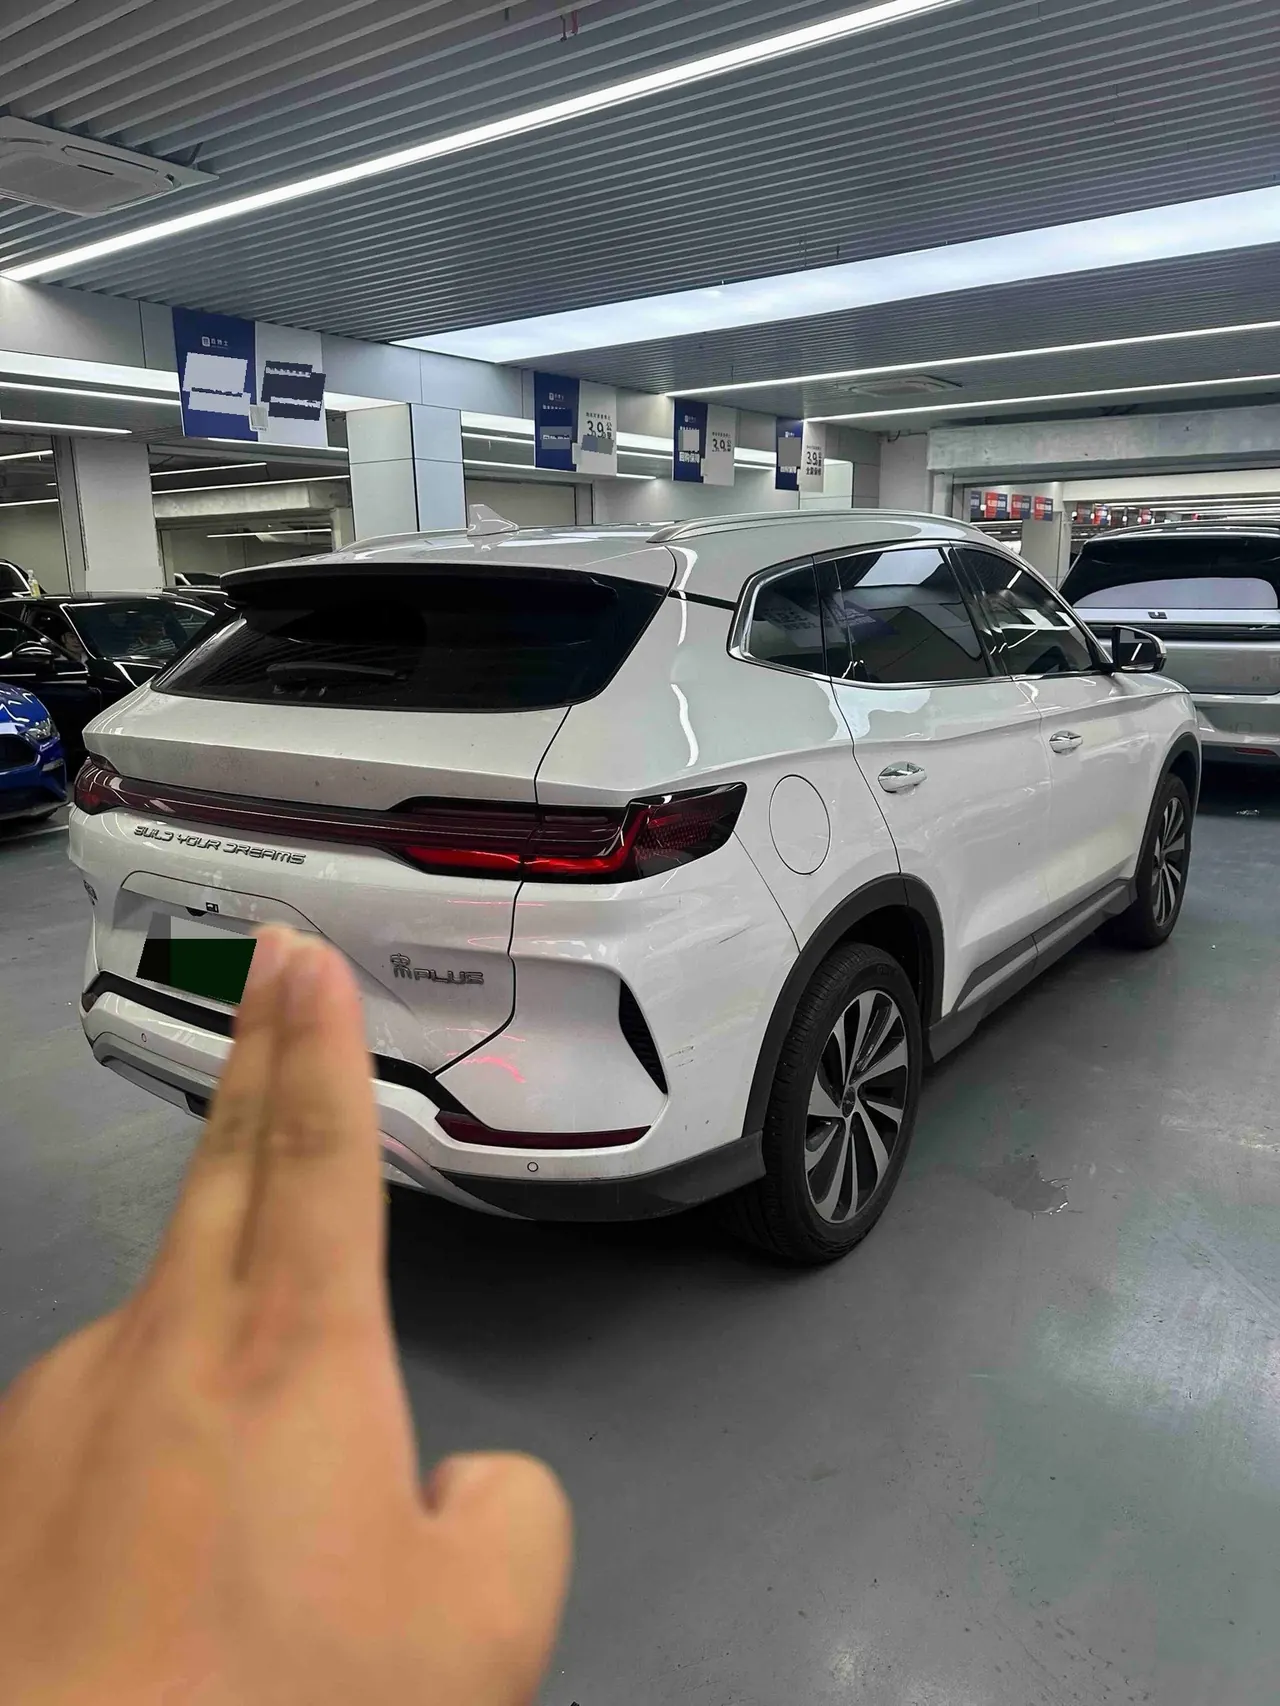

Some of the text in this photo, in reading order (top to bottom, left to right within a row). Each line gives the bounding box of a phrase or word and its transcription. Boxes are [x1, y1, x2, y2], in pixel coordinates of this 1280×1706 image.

[134, 825, 306, 865] BUILD YOUR DREAMS
[413, 968, 485, 985] PLUS
